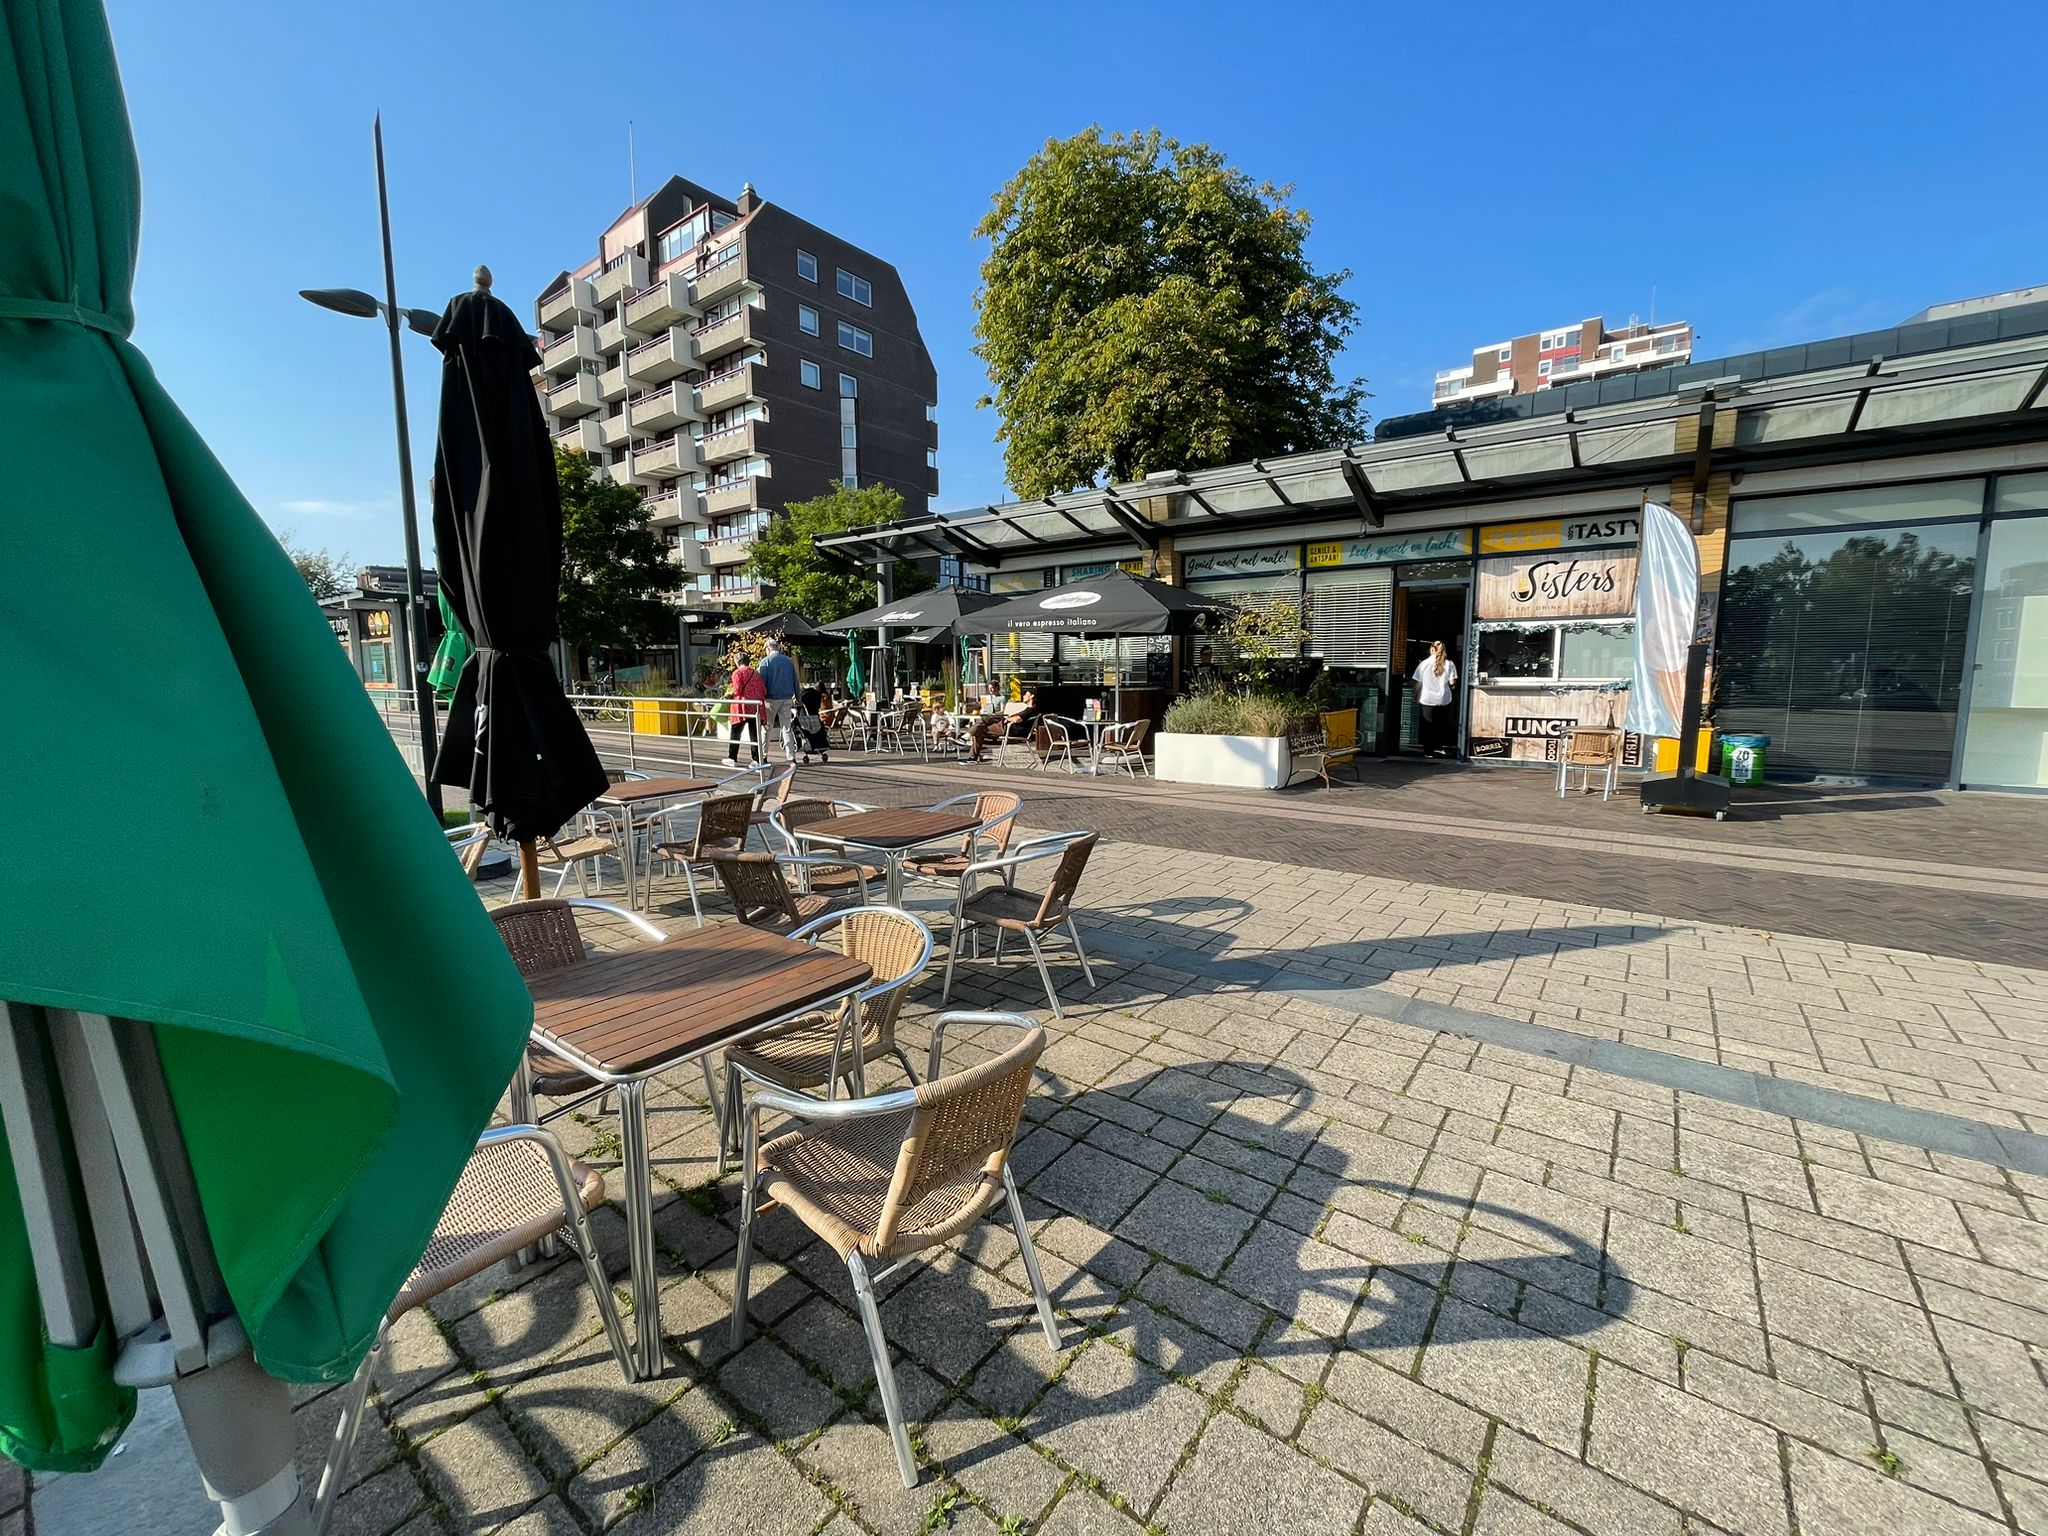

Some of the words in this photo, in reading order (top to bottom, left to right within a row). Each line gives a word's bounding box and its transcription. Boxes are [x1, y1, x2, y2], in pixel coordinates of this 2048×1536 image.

[1575, 519, 1639, 540] TASTY
[1071, 565, 1111, 577] SHARING
[1188, 556, 1215, 576] Geniet
[1241, 552, 1259, 566] met
[1511, 559, 1616, 602] Sisters
[1007, 619, 1013, 628] il
[1033, 619, 1065, 628] espresso
[1066, 616, 1097, 626] italiano
[1506, 718, 1577, 736] LUNCH
[1624, 731, 1639, 765] NTBIJT
